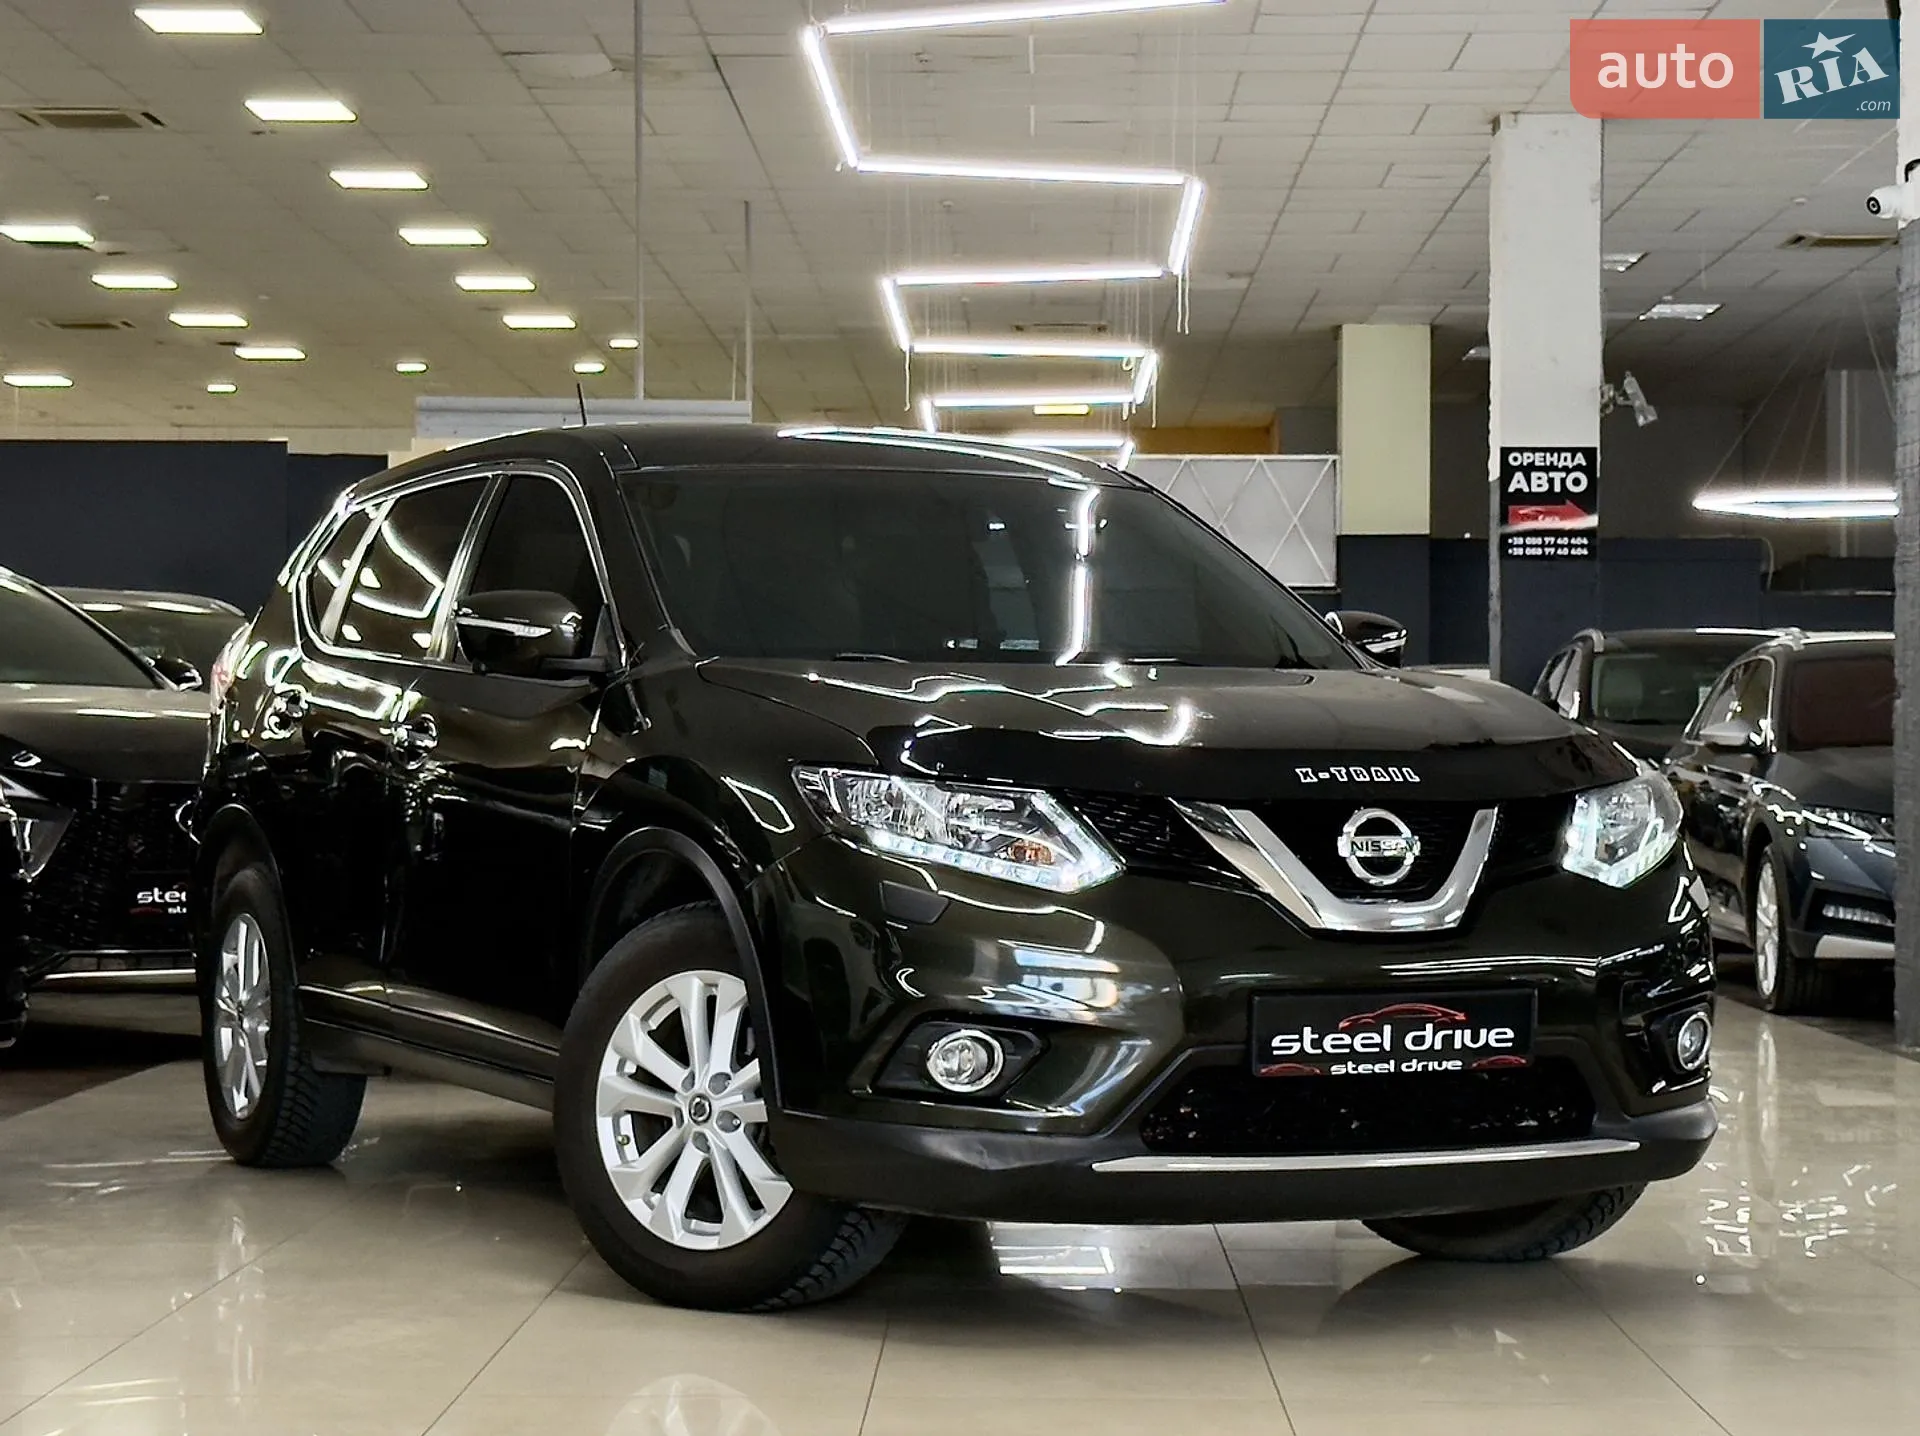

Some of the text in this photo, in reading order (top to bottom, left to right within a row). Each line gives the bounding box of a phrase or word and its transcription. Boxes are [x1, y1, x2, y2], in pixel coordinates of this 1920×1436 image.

[1508, 452, 1587, 468] ОРЕНДА
[1508, 471, 1588, 493] АВТО
[1295, 767, 1420, 782] X-TRAIL
[1350, 839, 1416, 852] NISSAN
[1271, 1023, 1514, 1055] steel drive
[1330, 1058, 1463, 1075] steel drive
